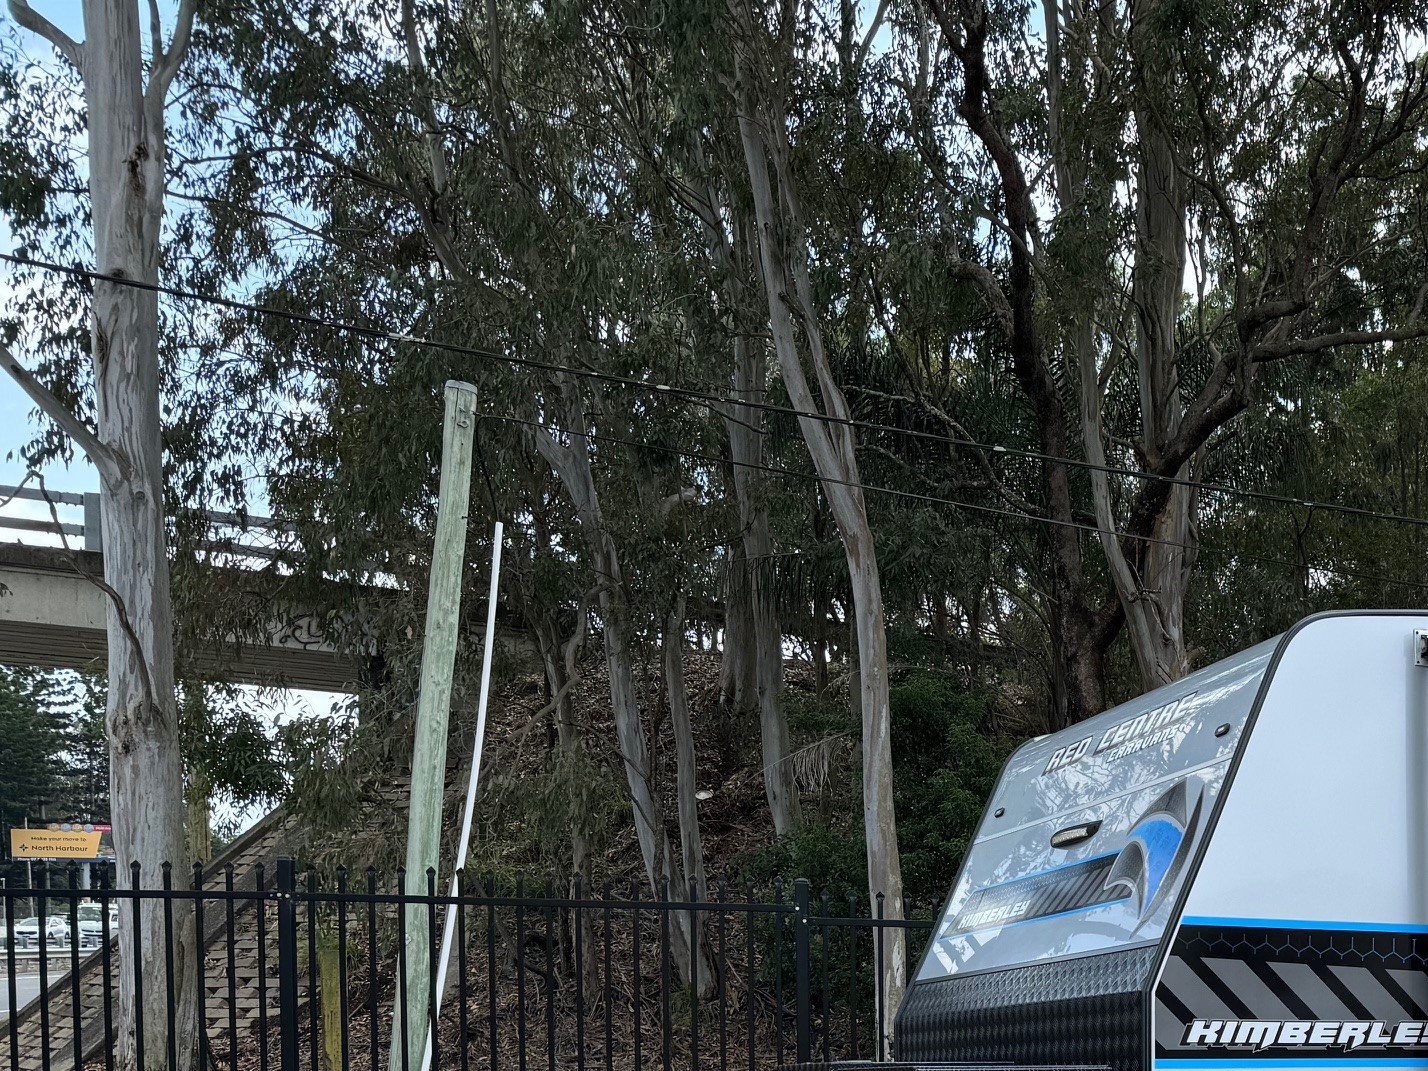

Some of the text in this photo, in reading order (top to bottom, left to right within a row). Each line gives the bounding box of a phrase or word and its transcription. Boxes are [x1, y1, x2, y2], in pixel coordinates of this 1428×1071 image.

[1043, 691, 1198, 776] RED CENTRE
[31, 844, 54, 852] North
[957, 899, 1032, 931] KIMBERLEY
